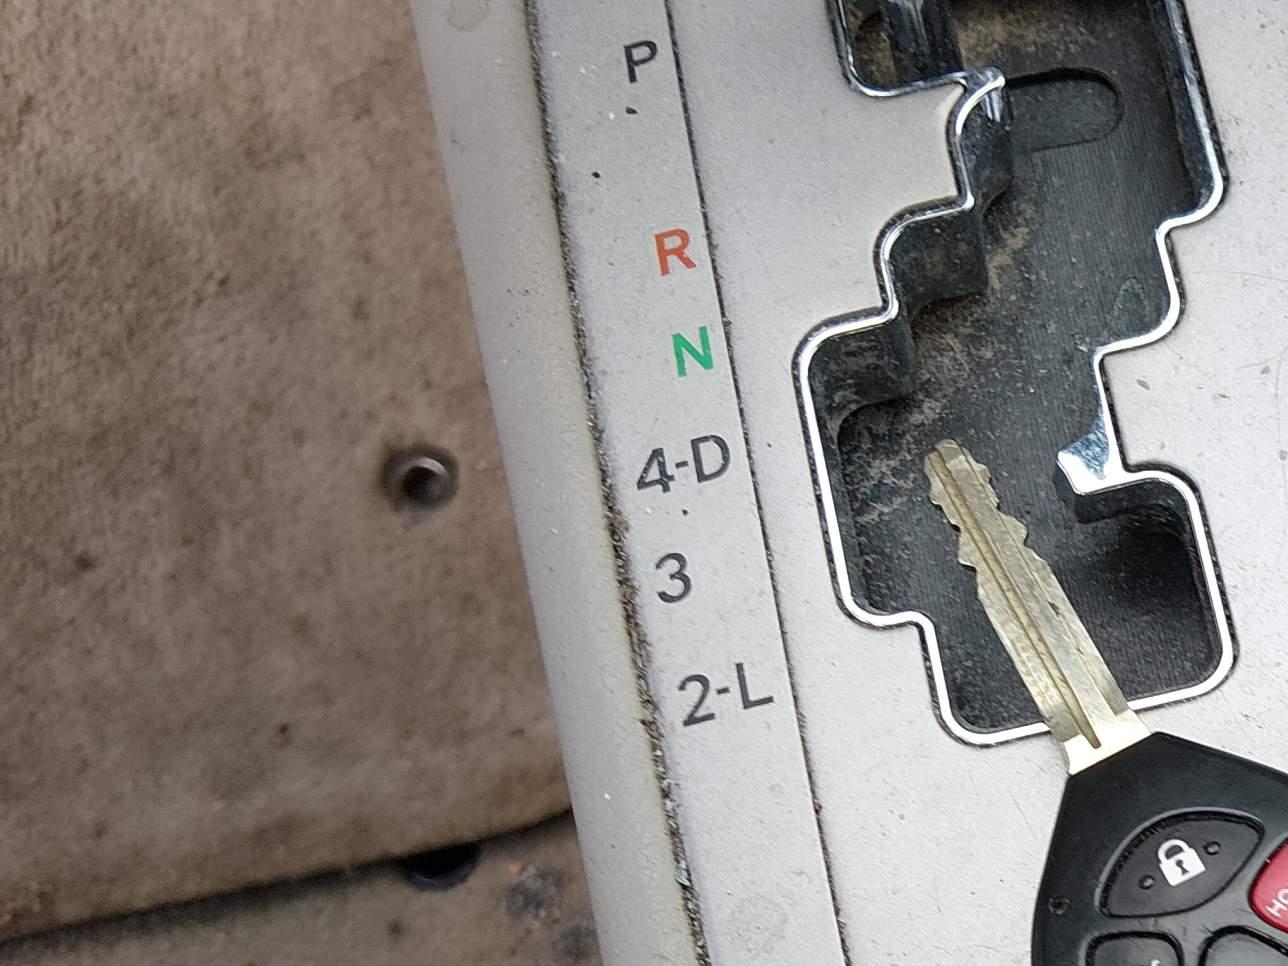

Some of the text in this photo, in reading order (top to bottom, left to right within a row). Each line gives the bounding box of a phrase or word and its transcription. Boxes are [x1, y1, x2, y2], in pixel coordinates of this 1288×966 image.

[623, 40, 658, 84] P
[654, 228, 697, 277] R
[671, 325, 714, 377] N
[637, 434, 731, 494] 4-D
[655, 552, 692, 604] 3
[677, 662, 774, 727] 2-L
